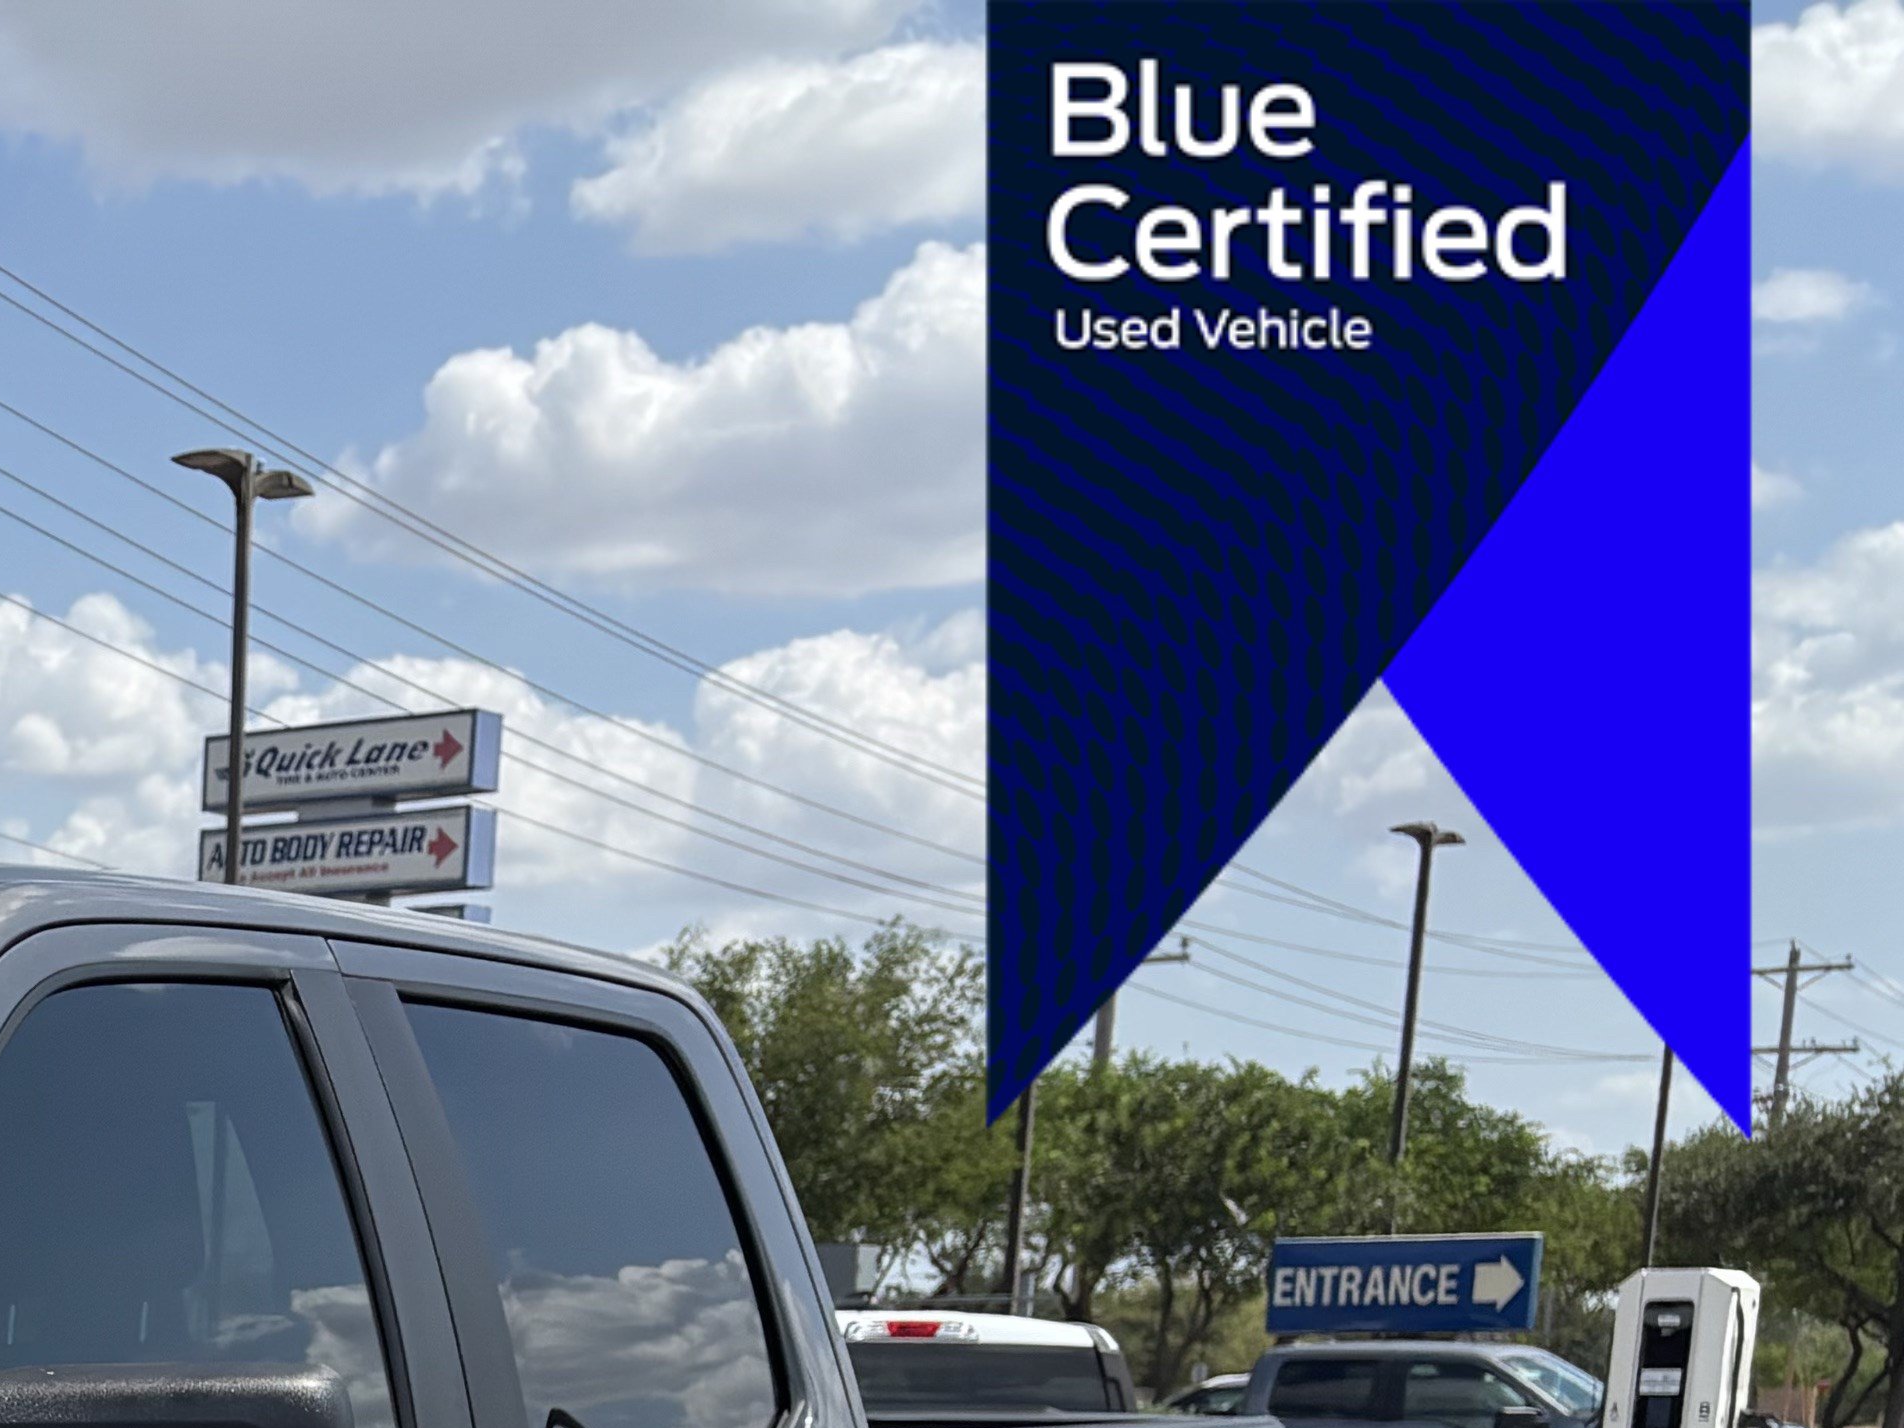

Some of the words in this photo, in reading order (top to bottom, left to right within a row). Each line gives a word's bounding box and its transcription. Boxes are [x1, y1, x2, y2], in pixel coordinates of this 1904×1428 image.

[256, 741, 343, 778] Quick
[345, 737, 429, 767] Lane
[349, 765, 400, 778] CENTER
[207, 838, 268, 871] ATO
[270, 832, 336, 864] BODY
[336, 825, 427, 859] REPAIR
[1272, 1264, 1461, 1308] ENTRANCE
